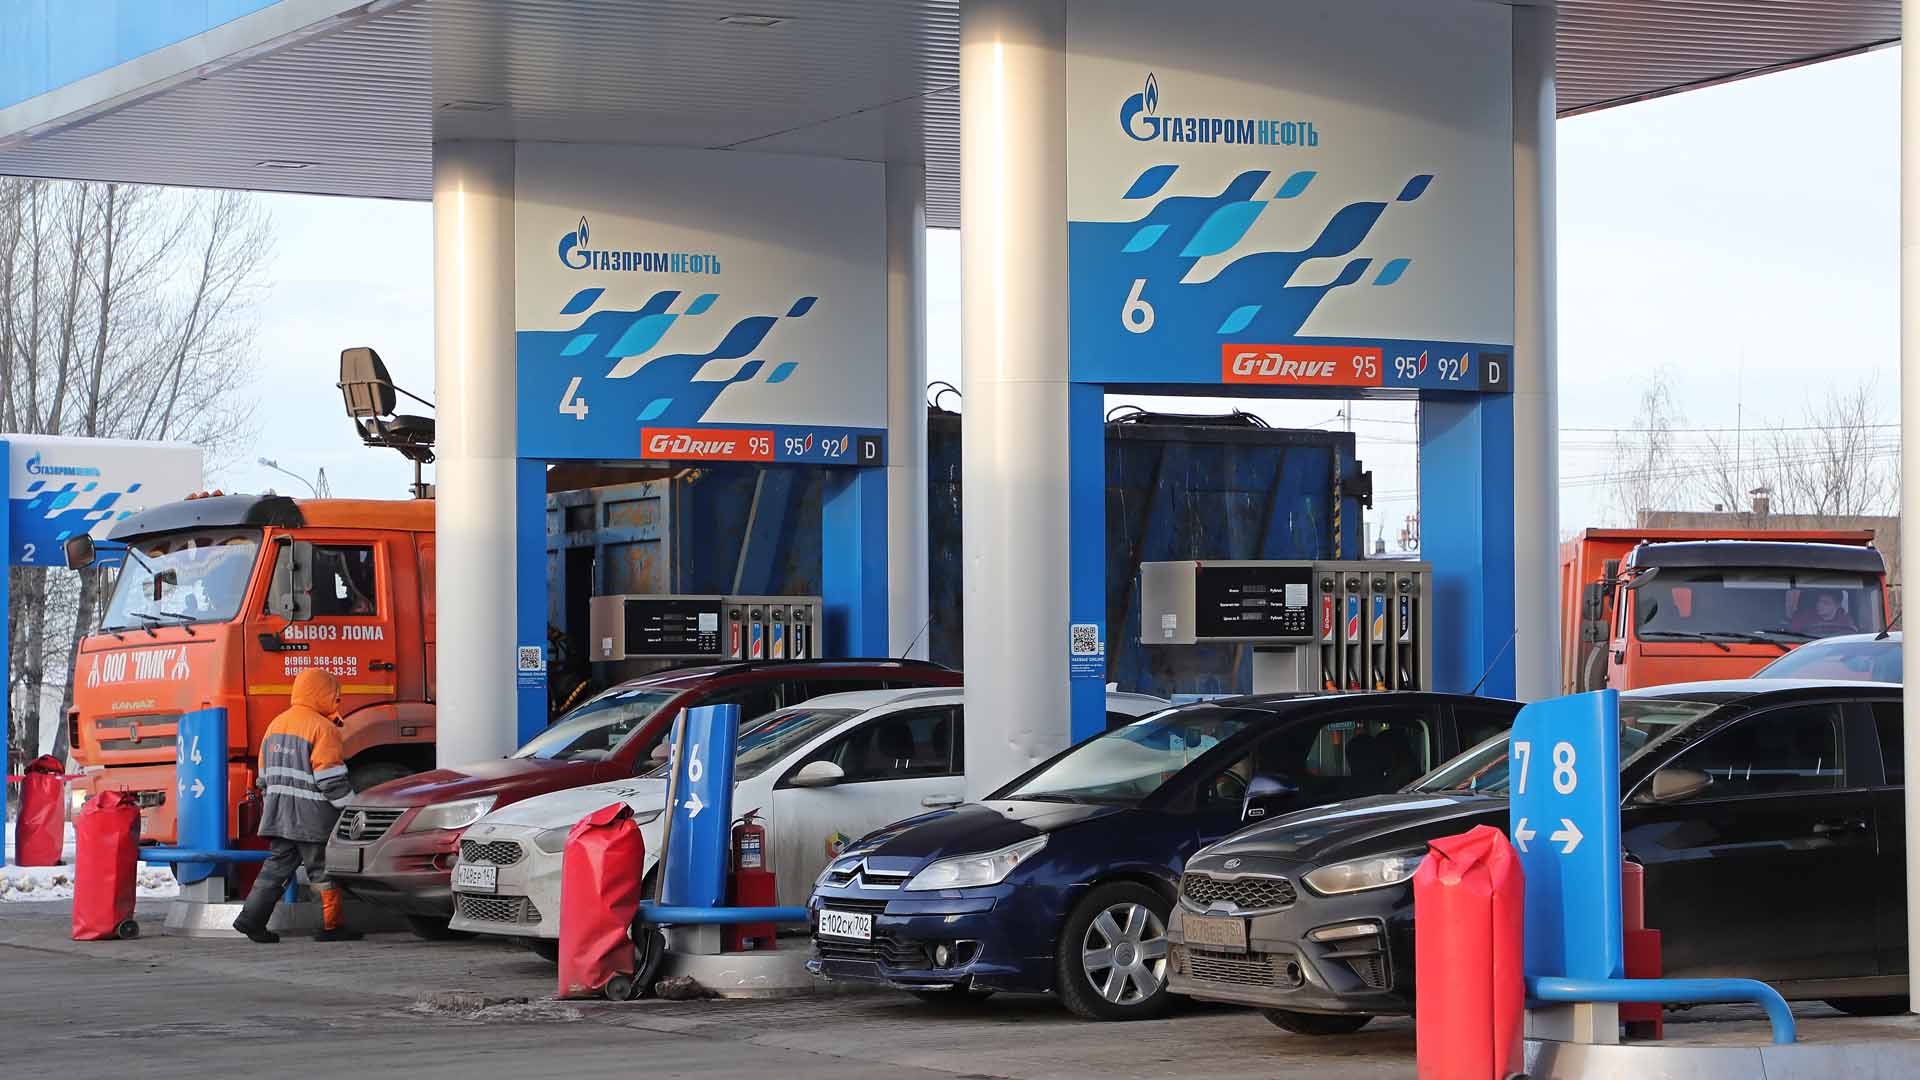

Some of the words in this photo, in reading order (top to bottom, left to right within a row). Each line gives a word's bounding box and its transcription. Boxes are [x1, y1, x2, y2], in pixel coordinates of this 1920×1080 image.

[1121, 278, 1155, 333] 6
[1352, 355, 1377, 378] 95
[1395, 356, 1418, 380] 95
[1438, 358, 1459, 381] 92
[1488, 361, 1501, 385] D
[559, 376, 589, 420] 4
[749, 437, 770, 455] 95
[784, 437, 804, 456] 95
[821, 439, 840, 457] 92
[864, 441, 876, 459] D
[21, 543, 36, 562] 2
[284, 625, 337, 640] ВЫВОЗ
[341, 625, 384, 641] ЛОМА
[103, 653, 128, 683] ООО
[178, 735, 185, 765] 3
[191, 735, 202, 765] 4
[688, 743, 703, 782] 6
[1514, 741, 1531, 794] 7
[1552, 741, 1577, 795] 8
[821, 914, 853, 935] Е102СК
[855, 916, 869, 932] 702
